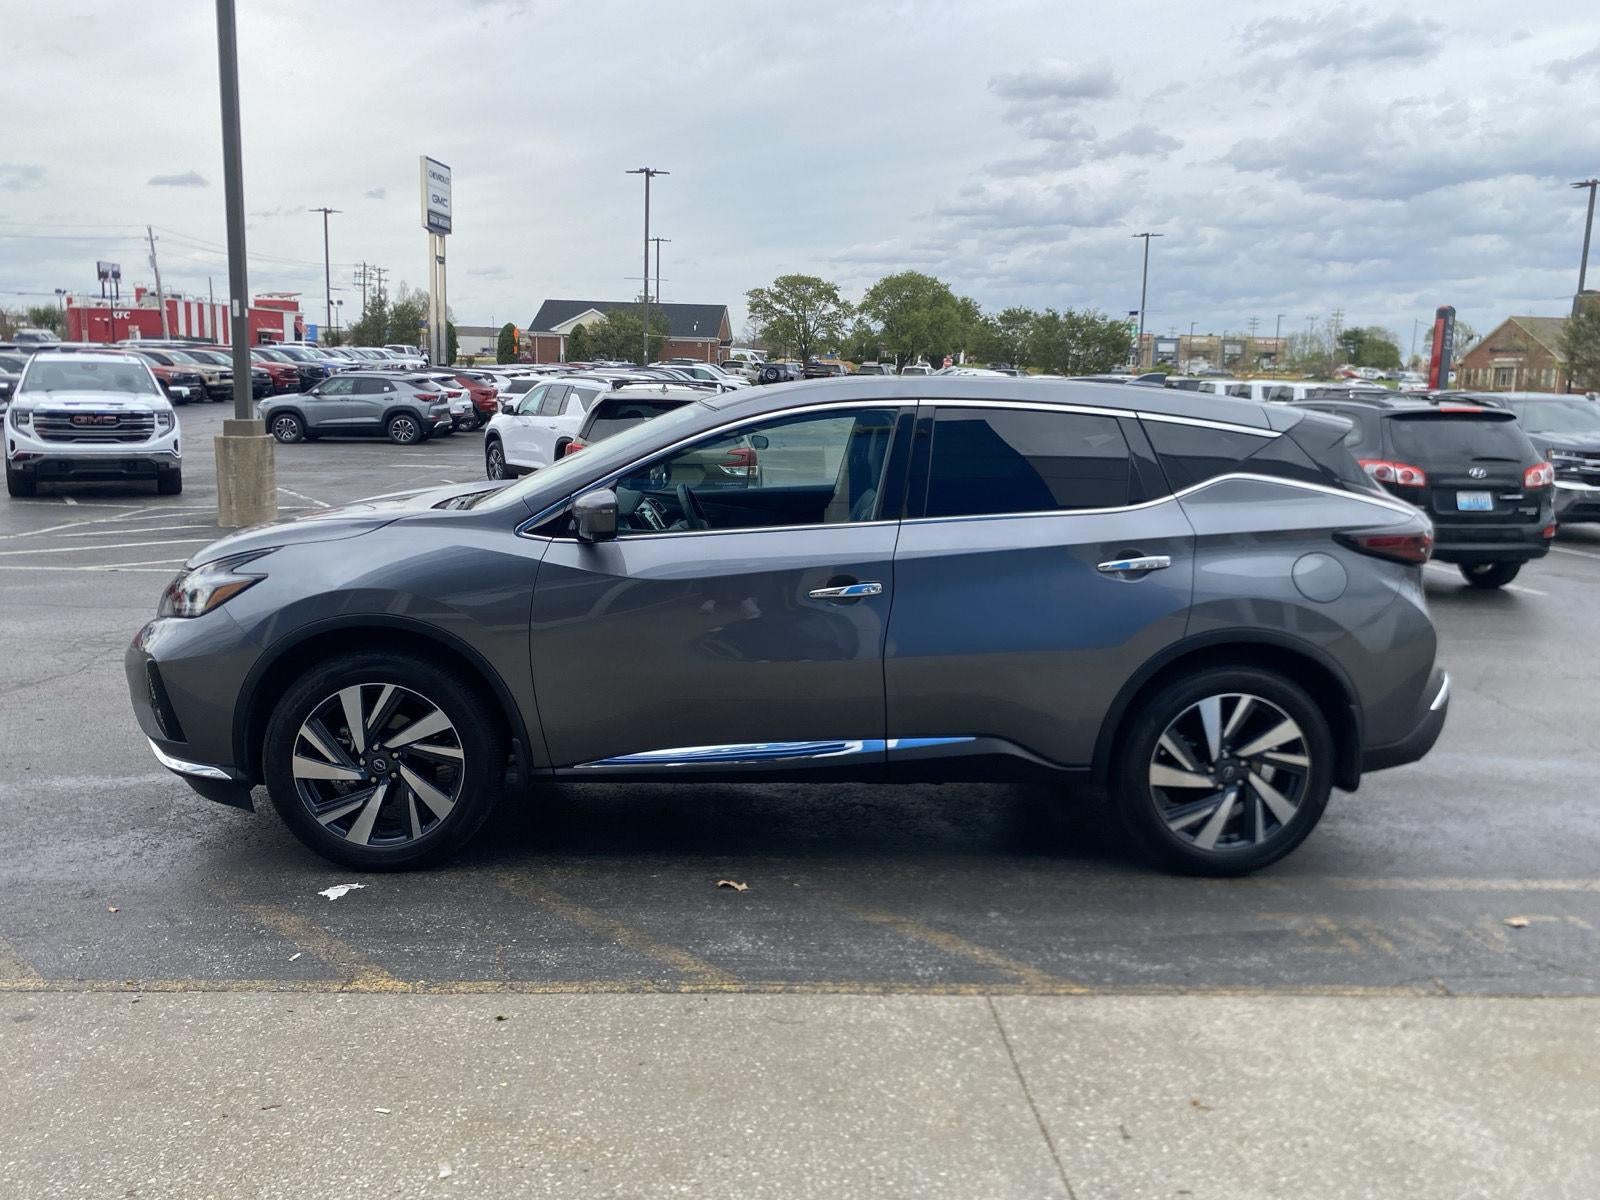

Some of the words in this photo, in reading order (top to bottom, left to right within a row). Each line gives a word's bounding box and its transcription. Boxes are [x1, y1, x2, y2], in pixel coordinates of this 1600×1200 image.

[428, 170, 450, 185] CHEVROLET
[432, 194, 448, 208] GMC
[112, 310, 131, 320] KFC
[73, 415, 117, 424] GMC
